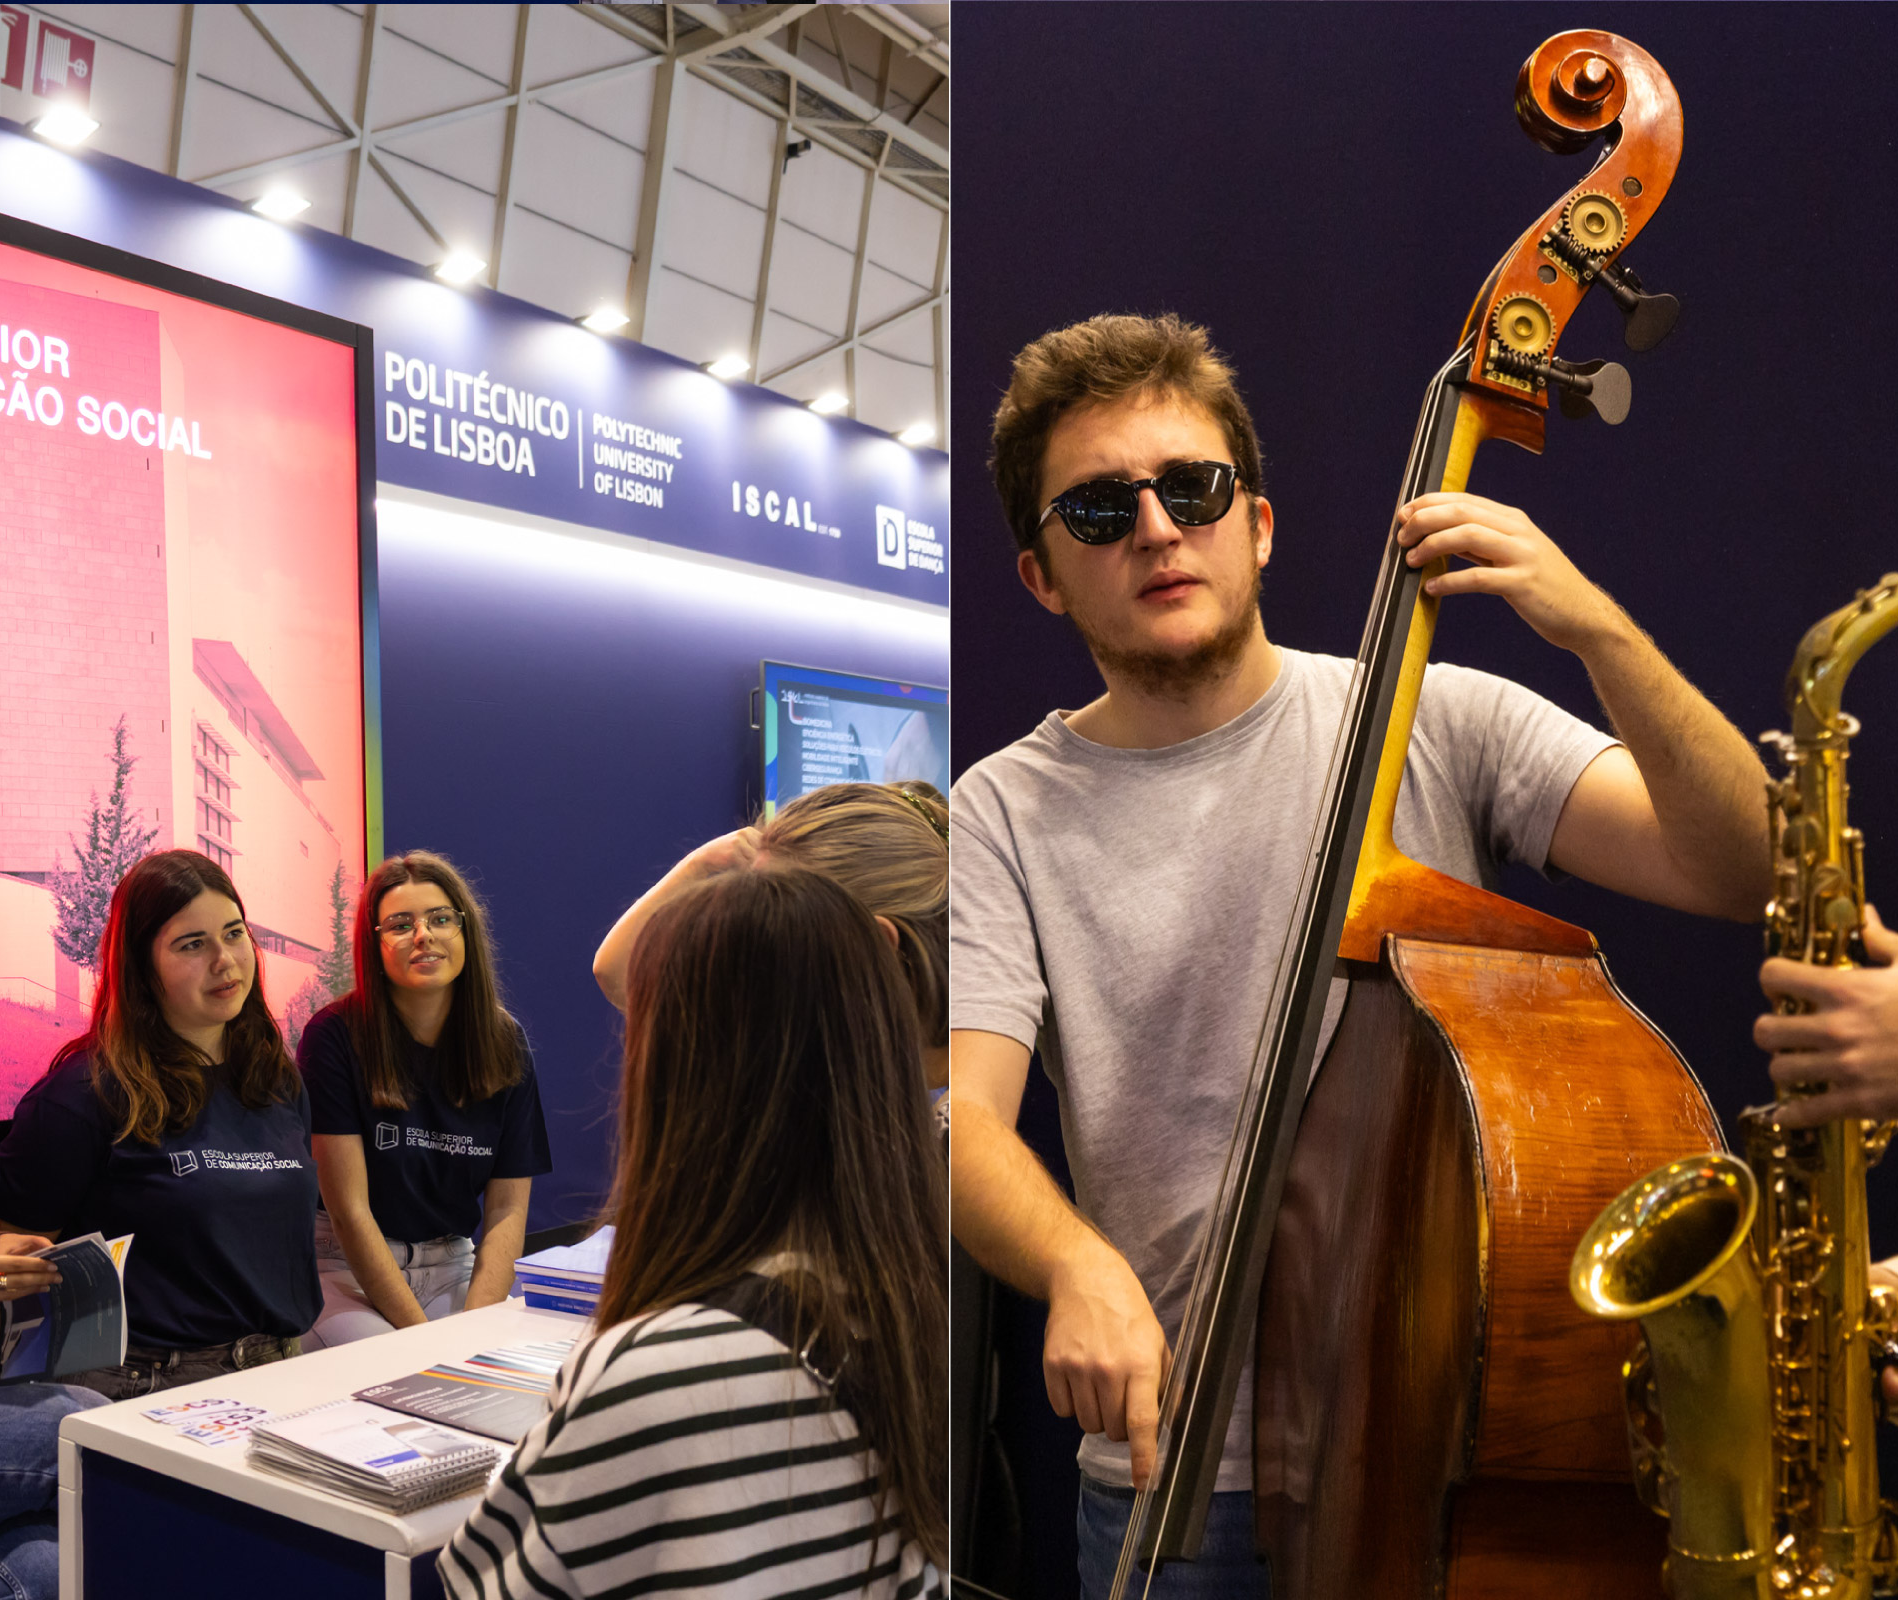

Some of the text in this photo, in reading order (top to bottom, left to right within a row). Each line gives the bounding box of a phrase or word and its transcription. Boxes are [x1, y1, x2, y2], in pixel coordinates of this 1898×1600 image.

[385, 352, 570, 440] POLITÉCNICO
[77, 396, 213, 460] SOCIAL
[386, 401, 535, 477] DE LISBOA
[593, 414, 682, 459] POLYTECHNIC
[594, 444, 674, 483] UNIVERSITY
[594, 472, 663, 508] OF LISBON
[733, 481, 817, 532] ISCAL
[233, 1151, 275, 1160] SUPERIOR
[274, 1160, 302, 1169] SOCIAL
